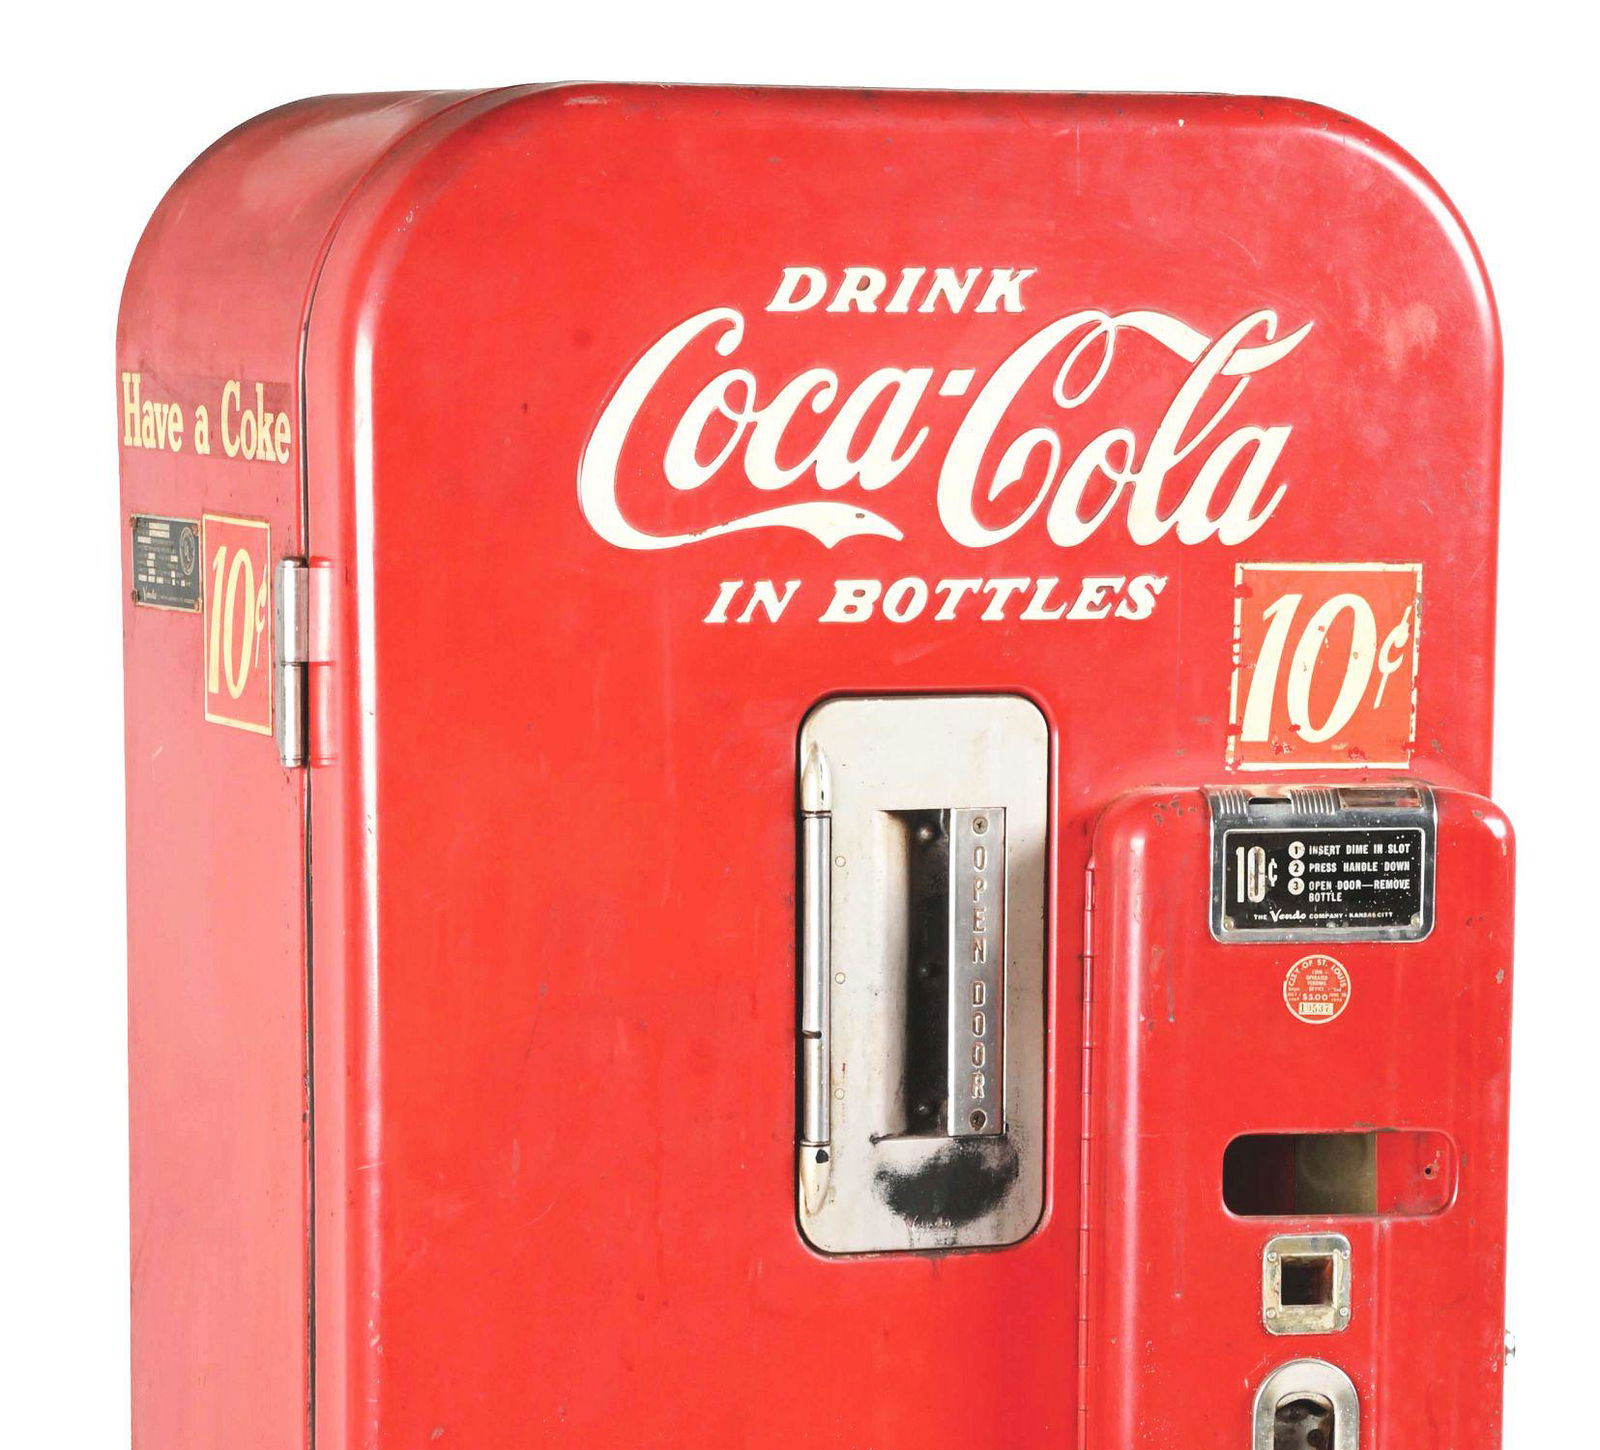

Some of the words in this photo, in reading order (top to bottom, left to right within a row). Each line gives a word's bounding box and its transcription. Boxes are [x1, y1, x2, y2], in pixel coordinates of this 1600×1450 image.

[765, 266, 1038, 313] DRINK
[122, 372, 184, 452] Have
[194, 404, 210, 455] a
[221, 379, 291, 465] Coke
[576, 307, 1314, 549] Coca-Cola
[208, 545, 268, 699] 10¢
[704, 579, 799, 624] IN
[818, 575, 1167, 624] BOTTLES
[1243, 593, 1412, 744] 10¢
[1309, 845, 1341, 856] INSERT
[1346, 844, 1369, 855] DIME
[1373, 844, 1383, 854] IN
[1388, 843, 1410, 854] SLOT
[1309, 862, 1337, 873] PRESS
[1343, 861, 1378, 872] HANDLE
[1384, 861, 1410, 871] DOWN
[1236, 846, 1278, 904] 10¢
[1309, 881, 1331, 891] OPEN
[1309, 892, 1342, 902] BOTTLE
[971, 846, 988, 964] OPEN
[1269, 908, 1306, 922] Vendo
[1302, 960, 1313, 969] OF
[1331, 964, 1347, 987] LOUIS
[971, 981, 987, 1100] DOOR
